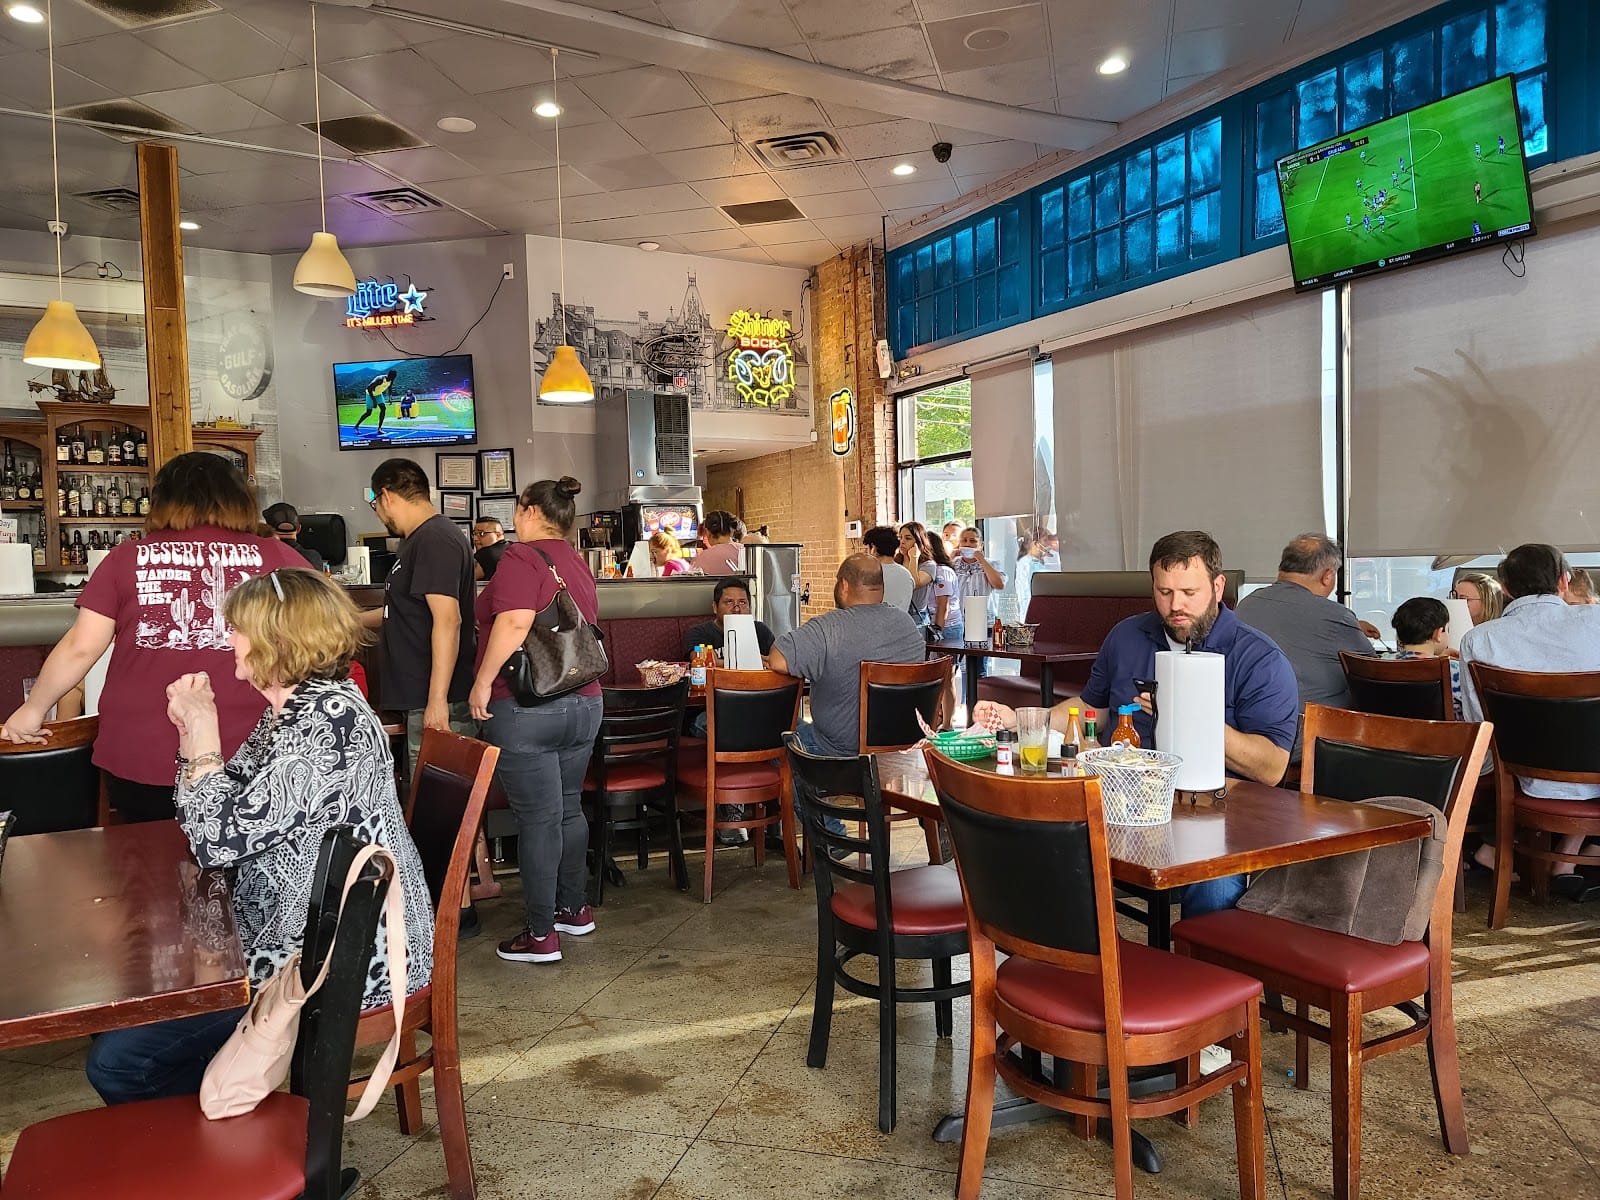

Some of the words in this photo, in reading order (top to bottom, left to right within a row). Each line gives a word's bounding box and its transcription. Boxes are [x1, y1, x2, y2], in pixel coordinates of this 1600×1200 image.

[346, 281, 398, 318] Lite
[346, 317, 362, 328] IT'S
[362, 315, 393, 327] MILLER
[393, 313, 414, 325] TIME
[727, 310, 791, 338] Shiner
[740, 337, 780, 349] BOCK
[224, 349, 256, 369] GULF
[136, 541, 205, 567] DESERT
[208, 541, 263, 567] STARS
[136, 569, 192, 581] WANDER
[136, 581, 162, 593] THE
[137, 592, 173, 605] WEST
